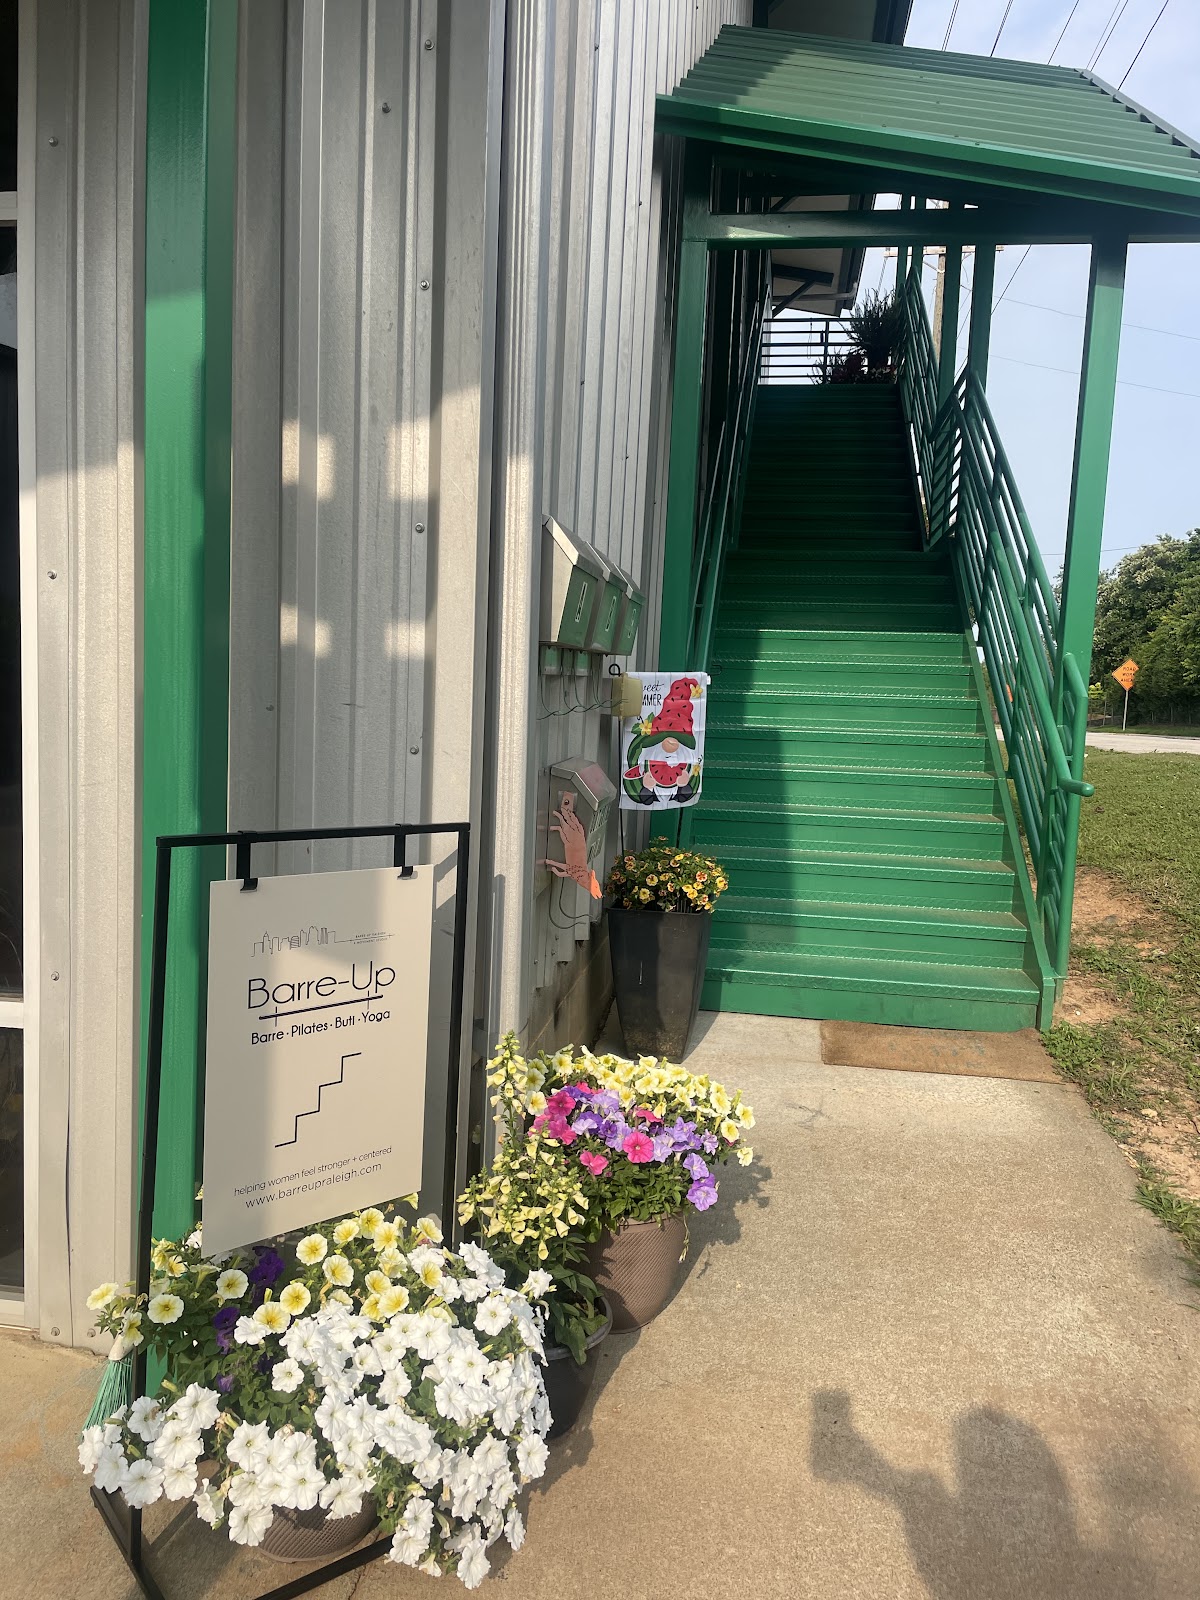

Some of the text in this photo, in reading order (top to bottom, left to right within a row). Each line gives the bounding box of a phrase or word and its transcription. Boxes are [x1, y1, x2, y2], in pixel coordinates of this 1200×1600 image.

[642, 693, 662, 706] MMER
[247, 960, 396, 1009] Barre-Up
[251, 1030, 284, 1045] Barre
[361, 1010, 390, 1023] Yoga
[233, 1181, 266, 1197] helping
[268, 1172, 300, 1187] women
[301, 1166, 316, 1178] feel
[317, 1158, 351, 1174] stronger
[358, 1145, 392, 1162] centered
[245, 1162, 382, 1209] www.barreupraleigh.com
